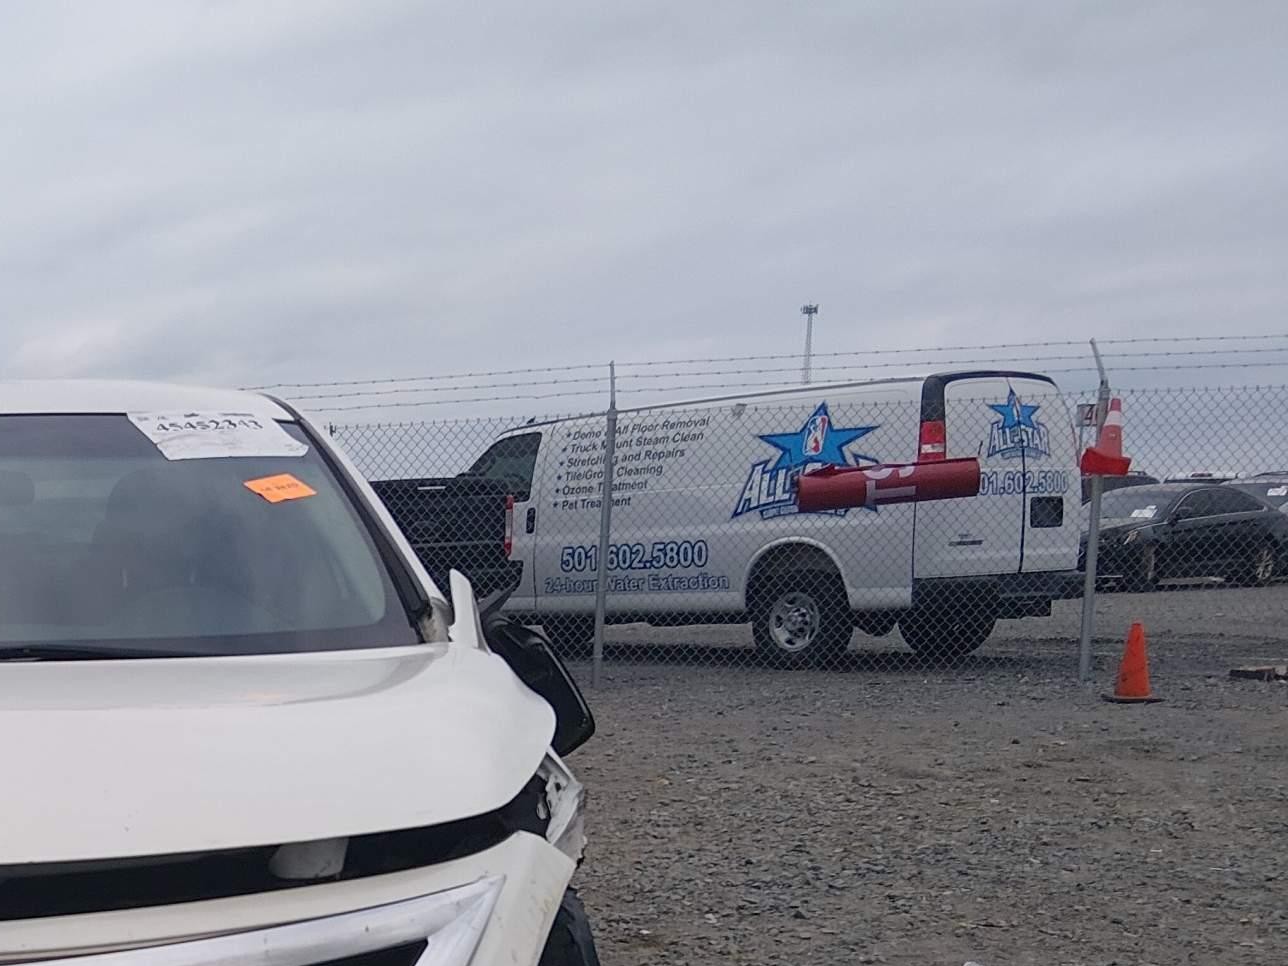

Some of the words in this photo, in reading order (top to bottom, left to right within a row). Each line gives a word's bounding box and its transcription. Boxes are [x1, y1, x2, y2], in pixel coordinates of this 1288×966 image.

[572, 431, 601, 441] Demo
[630, 423, 659, 434] Floor
[662, 416, 711, 430] Removal
[570, 443, 598, 453] Truck
[600, 438, 633, 450] Munt
[635, 434, 670, 446] Steam
[671, 431, 704, 443] Clean
[567, 454, 619, 468] Stretchig
[620, 451, 641, 462] and
[644, 448, 686, 461] Repairs
[616, 463, 664, 477] Cleaning
[562, 484, 594, 495] Ozone
[979, 470, 1070, 496] 01.602.5800
[561, 500, 578, 510] Pet
[561, 540, 708, 572] 501602.5800
[647, 572, 729, 591] Extraction
